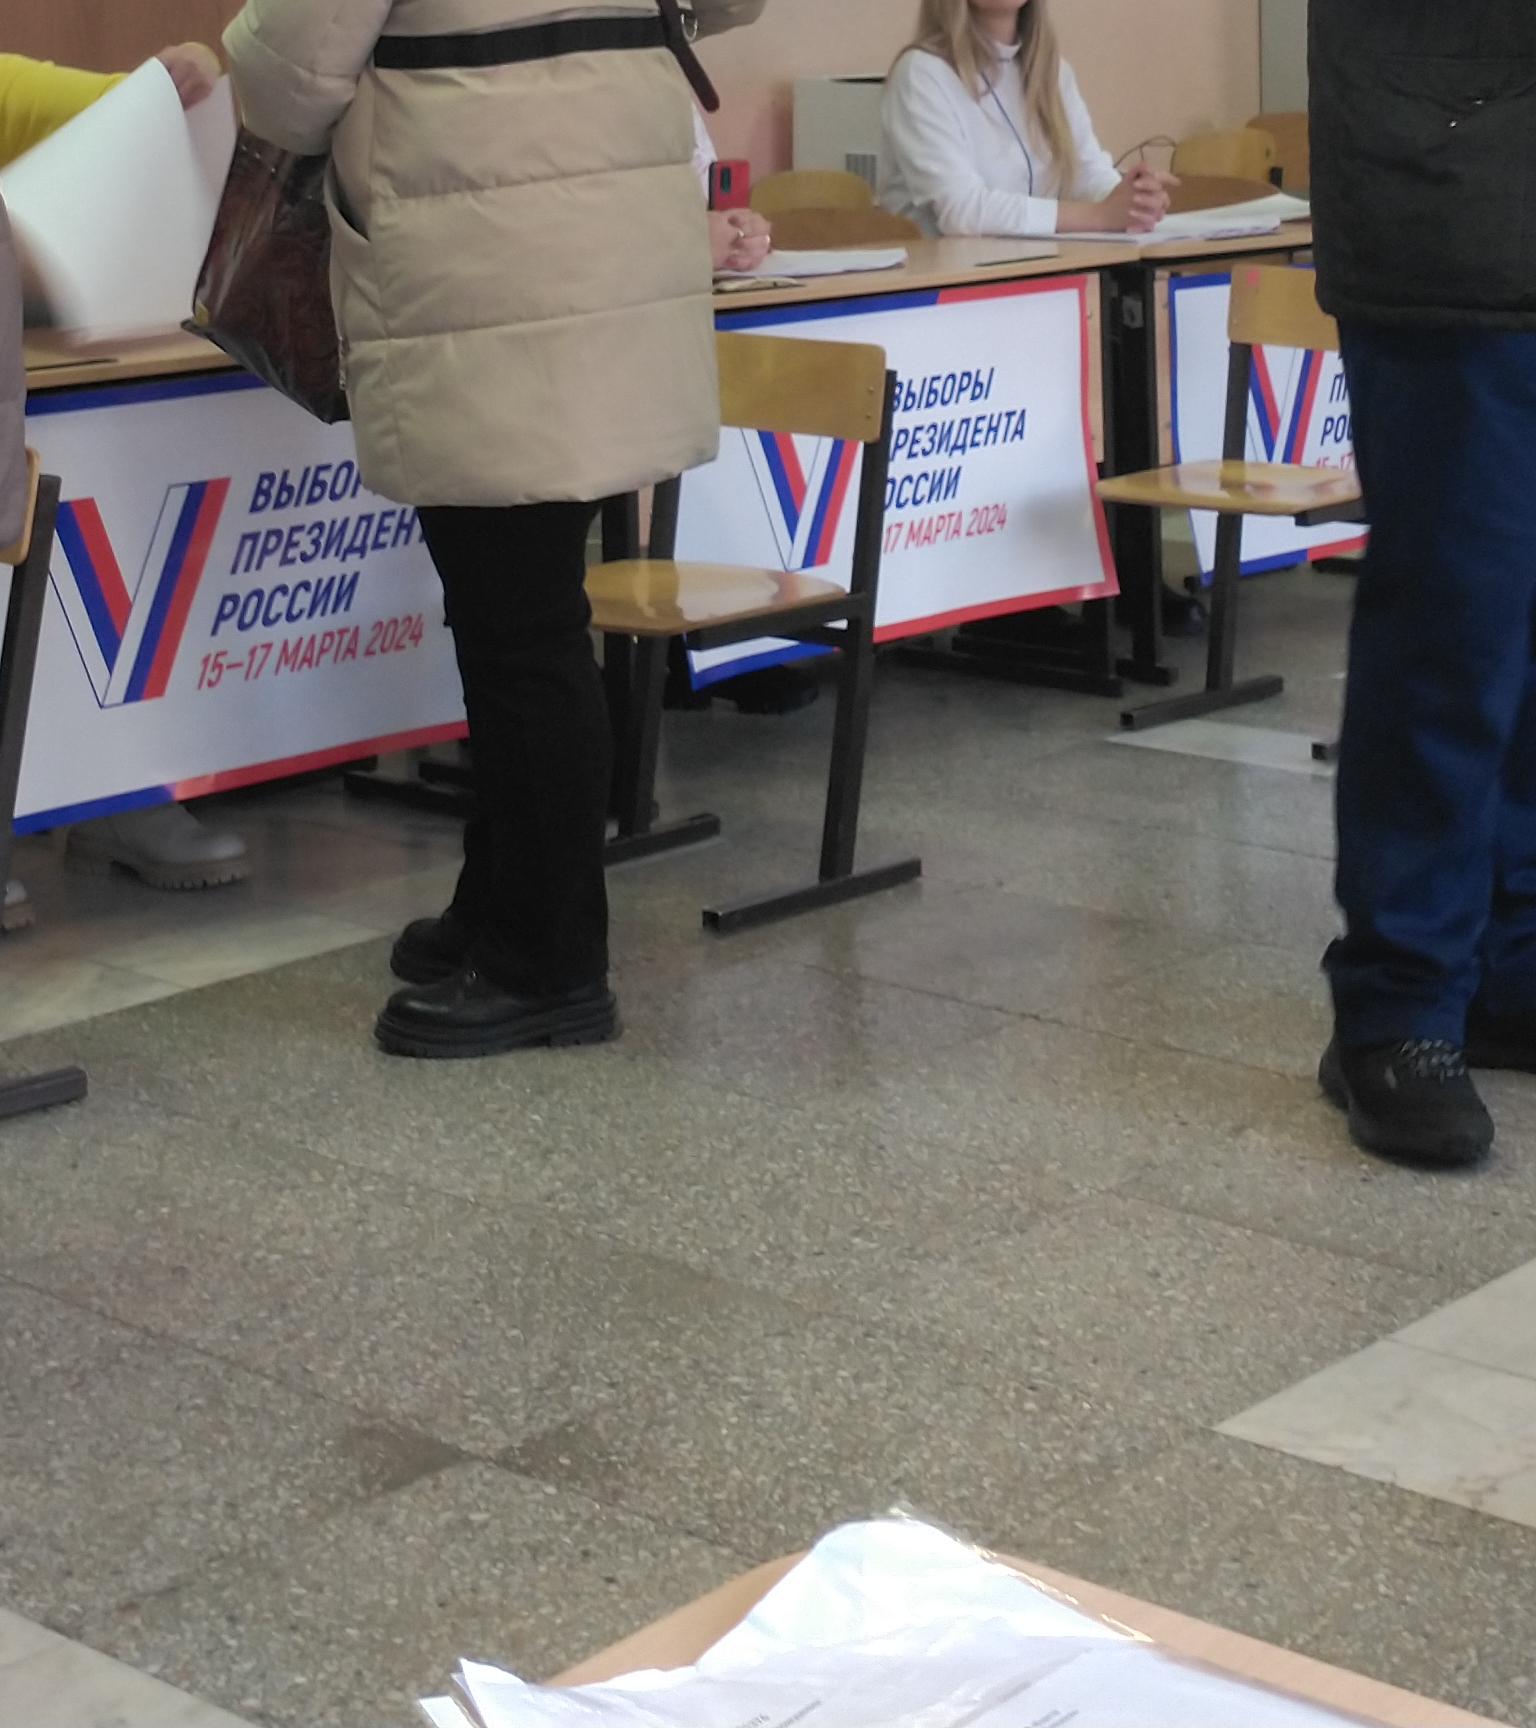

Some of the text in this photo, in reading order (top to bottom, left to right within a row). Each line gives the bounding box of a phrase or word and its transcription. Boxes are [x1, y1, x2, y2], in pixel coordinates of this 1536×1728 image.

[893, 367, 994, 413] ВЫБОРЫ
[889, 408, 1026, 462] РЕЗИДЕНТА
[249, 459, 362, 514] ВЫБО
[883, 466, 962, 511] ОССИИ
[230, 506, 425, 575] ПРЕЗИДЕН
[904, 509, 963, 550] МАРТА
[965, 501, 1008, 538] 2024
[210, 570, 360, 637] РОССИИ
[274, 625, 360, 676] МАРТА
[364, 613, 425, 658] 2024
